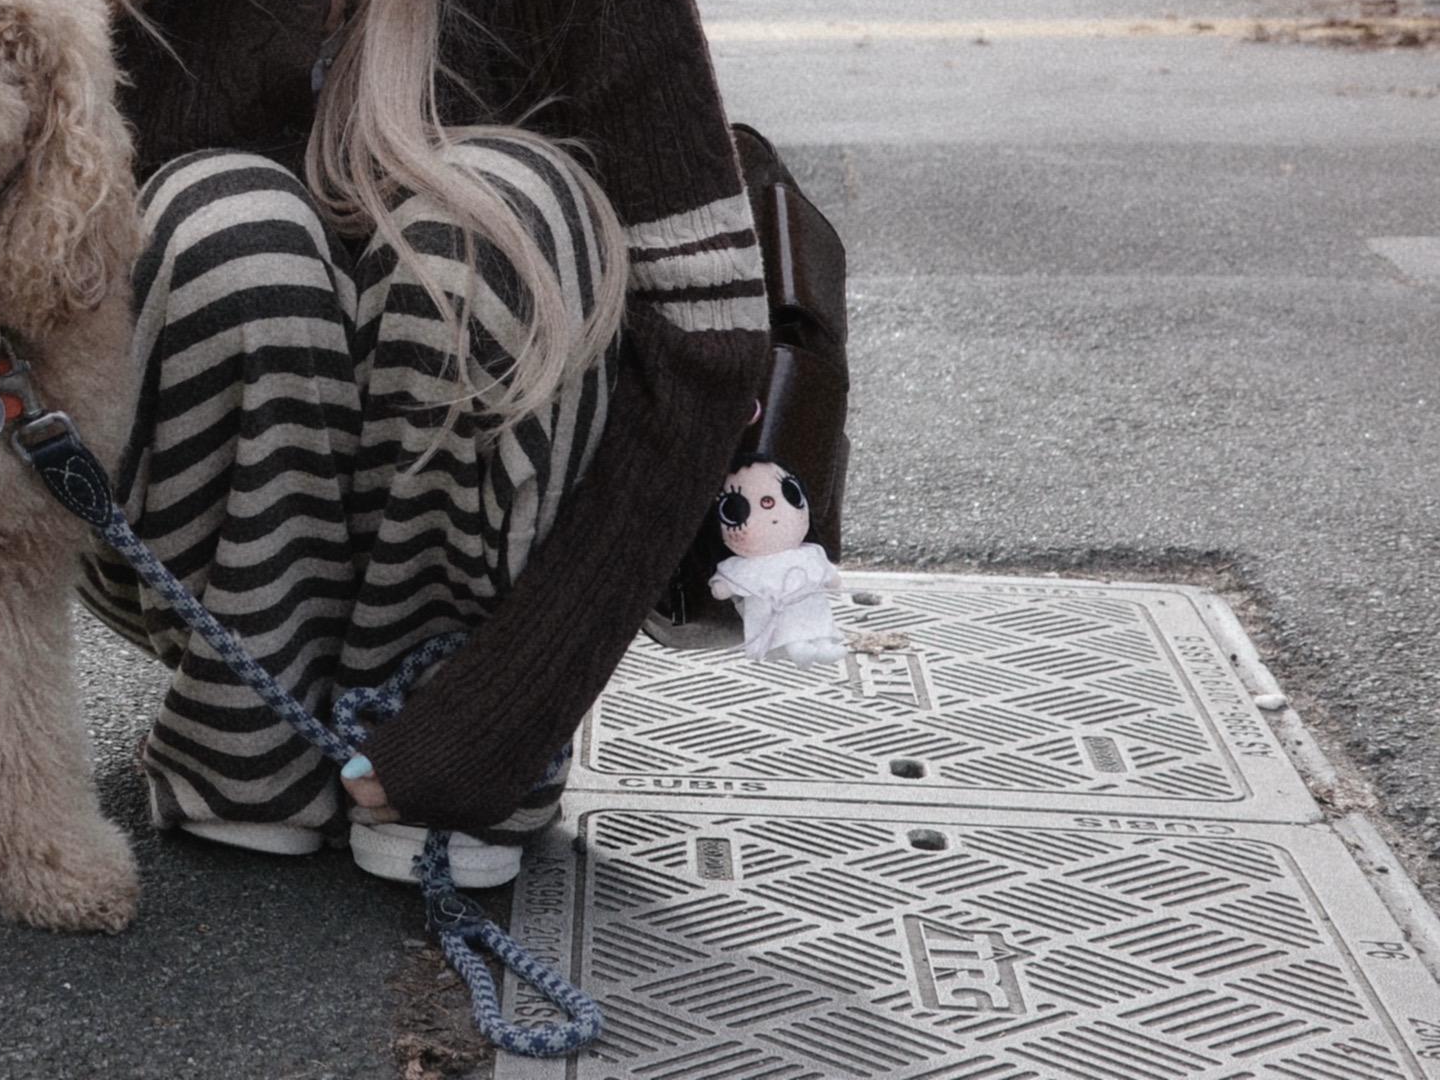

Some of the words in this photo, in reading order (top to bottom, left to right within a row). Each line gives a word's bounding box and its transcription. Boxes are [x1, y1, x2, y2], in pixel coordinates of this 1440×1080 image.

[1178, 645, 1227, 679] CLASS
[1238, 740, 1278, 760] AS
[618, 777, 768, 793] CUBIS
[1072, 817, 1236, 836] CUBIS
[526, 854, 567, 877] AS
[1359, 939, 1411, 961] P6
